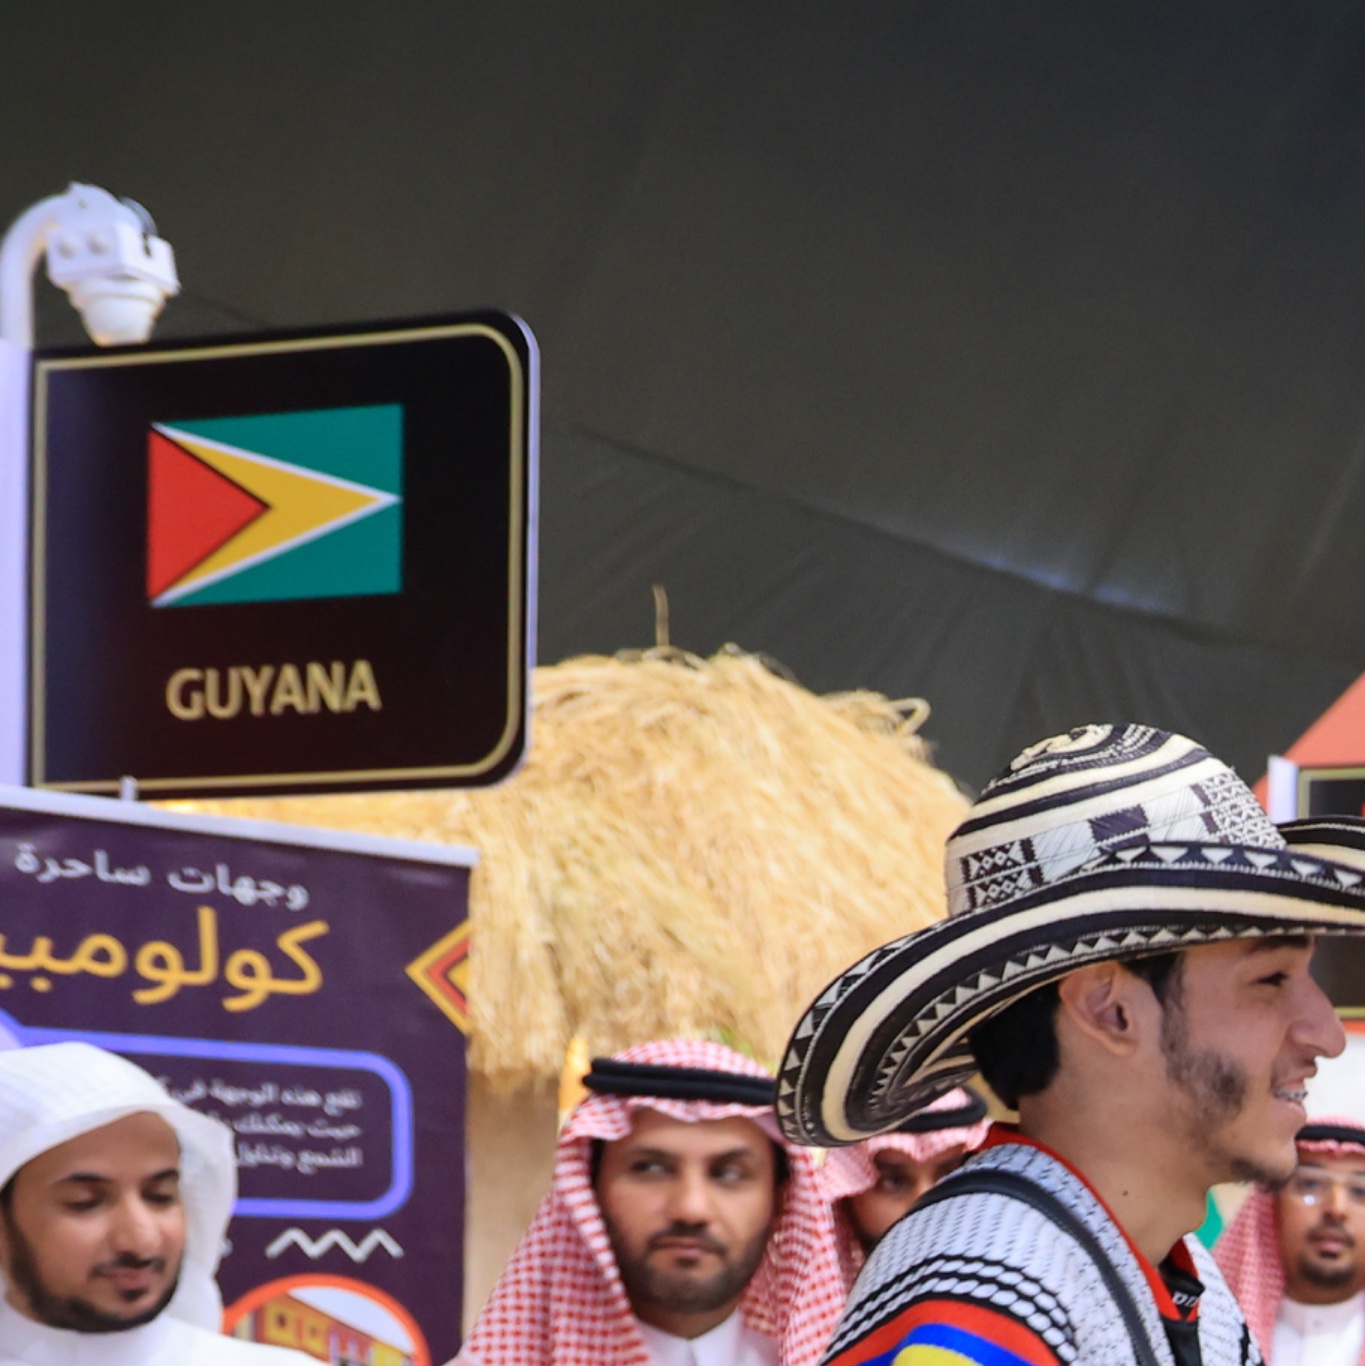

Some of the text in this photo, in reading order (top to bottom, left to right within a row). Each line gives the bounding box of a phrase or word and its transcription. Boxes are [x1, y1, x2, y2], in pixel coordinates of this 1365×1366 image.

[165, 658, 383, 721] GUYANA
[14, 842, 309, 911] وجهات ساحرة
